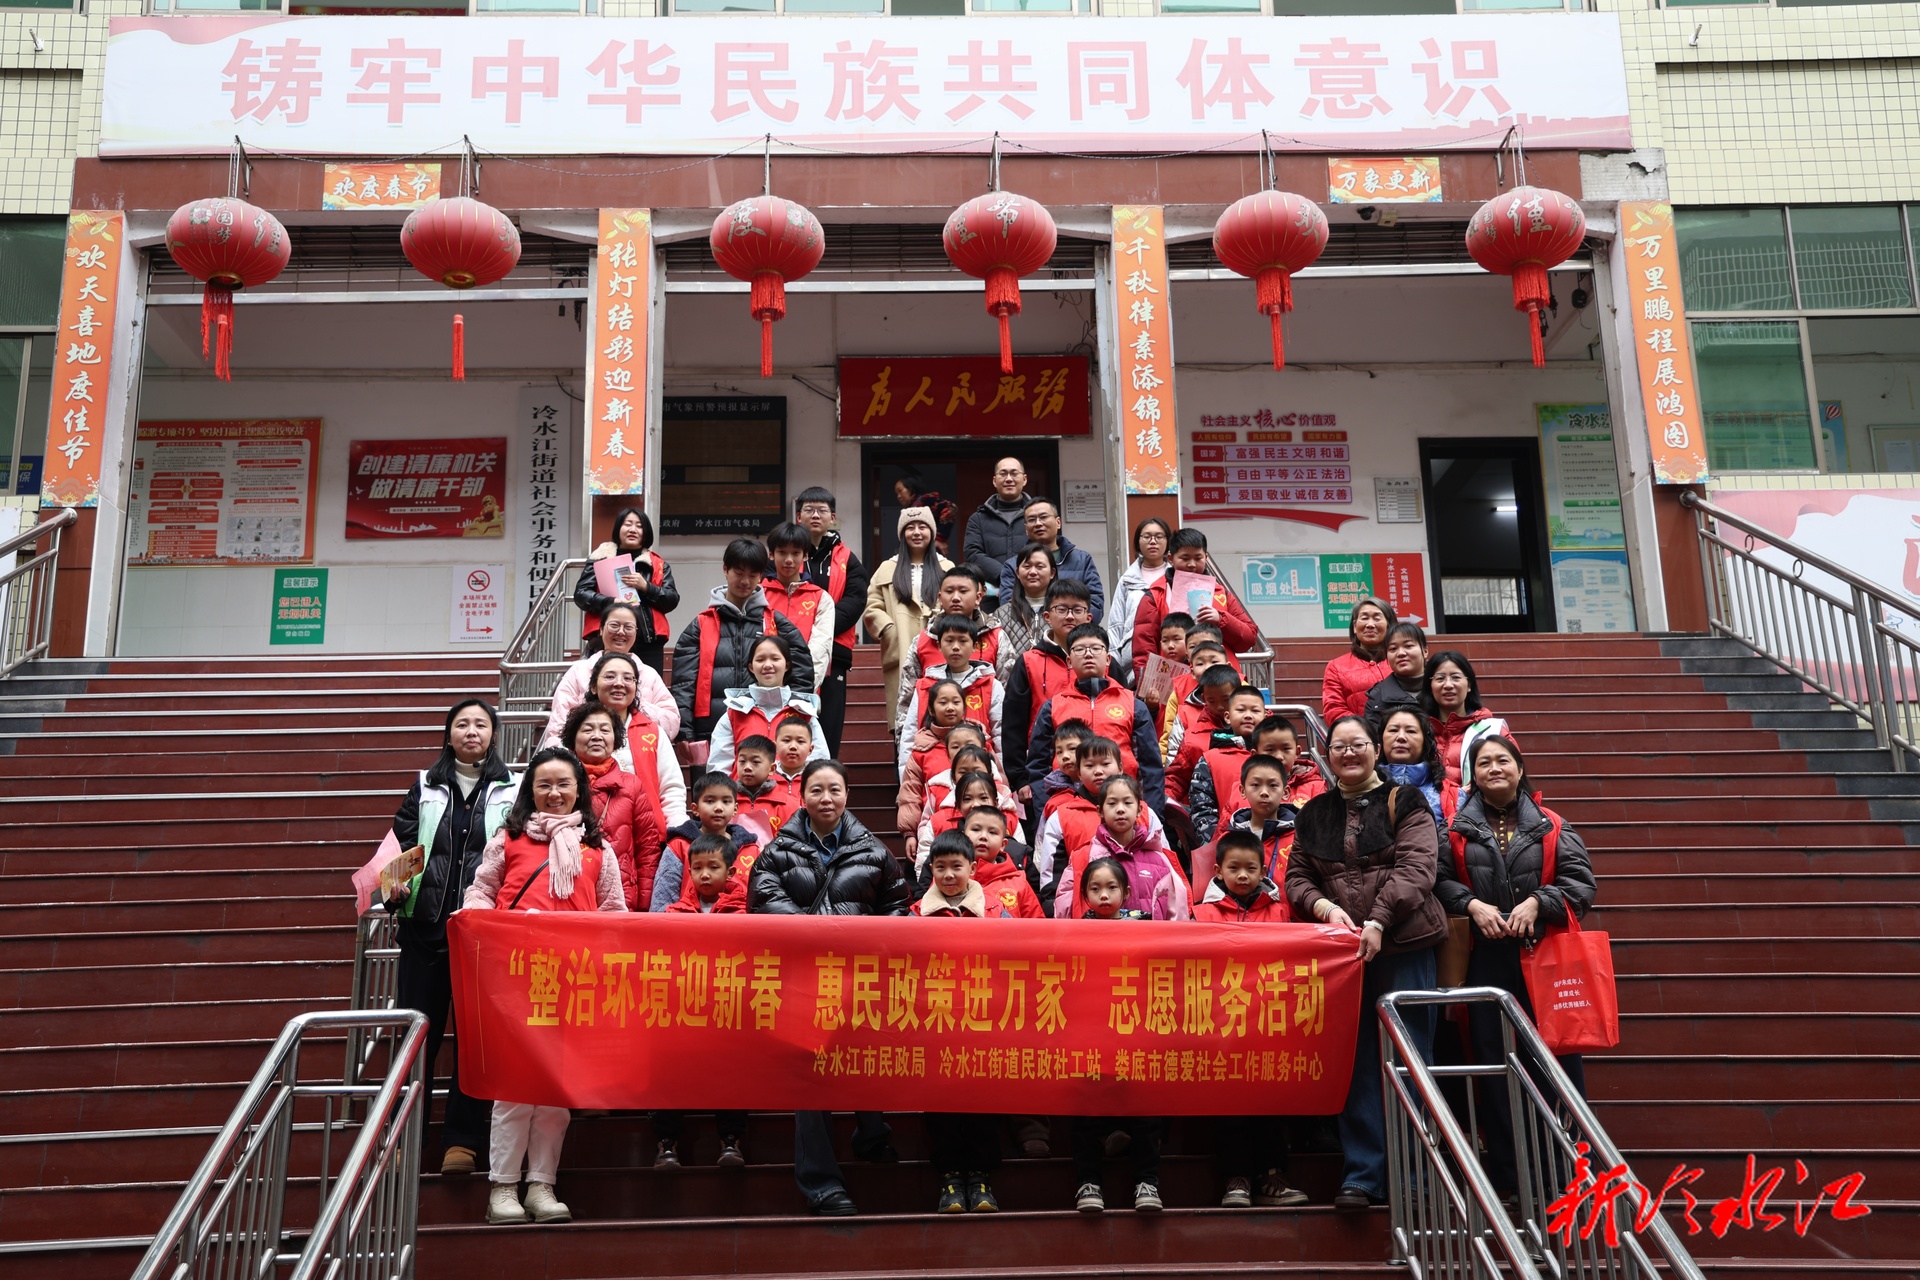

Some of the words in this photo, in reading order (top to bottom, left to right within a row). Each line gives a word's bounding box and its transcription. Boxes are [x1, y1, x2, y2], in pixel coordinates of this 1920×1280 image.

[221, 37, 1513, 124] 铸牢中华民族共同体意识
[1337, 167, 1431, 193] 万象更新
[333, 173, 432, 200] 欢度春节
[1636, 234, 1690, 450] 万里鹏程展鸿图
[602, 239, 638, 459] 张灯结彩迎新春
[57, 244, 108, 470] 欢天喜地度佳节
[1202, 408, 1337, 429] 社会主义核心价值观
[1197, 433, 1233, 441] 人民有信仰
[1252, 433, 1288, 441] 民族有希望
[1307, 432, 1343, 440] 国家有力量
[1200, 449, 1217, 458] 国家
[1236, 447, 1260, 459] 富强
[1264, 447, 1289, 459] 民主
[1292, 447, 1316, 459] 文明
[1320, 447, 1345, 459] 和谐
[357, 452, 498, 475] 创建清廉机关
[1201, 470, 1218, 479] 社会
[1238, 469, 1260, 480] 自由
[1265, 469, 1289, 480] 平等
[1293, 469, 1317, 480] 公正
[1321, 468, 1345, 480] 法治
[368, 477, 486, 499] 做清廉干部
[1238, 489, 1262, 500] 爱国
[1266, 489, 1291, 500] 敬业
[1295, 489, 1319, 500] 诚信
[1323, 488, 1347, 500] 友善
[1202, 491, 1219, 499] 公民
[660, 519, 680, 528] 政府
[695, 519, 760, 528] 冷水江市气象局
[1329, 563, 1363, 573] 温馨提示
[1251, 582, 1292, 596] 吸烟处
[1327, 582, 1369, 592] 您已进入
[509, 947, 783, 1030] “整治环境迎新春
[813, 951, 1087, 1035] 惠民政策进万家”
[1108, 955, 1325, 1037] 志愿服务活动
[1558, 989, 1581, 998] 健康成长
[813, 1045, 926, 1078] 冷水江市民政局
[939, 1046, 1102, 1081] 冷水江街道民政社工站
[1115, 1048, 1323, 1082] 娄底市德爱社会工作服务中心
